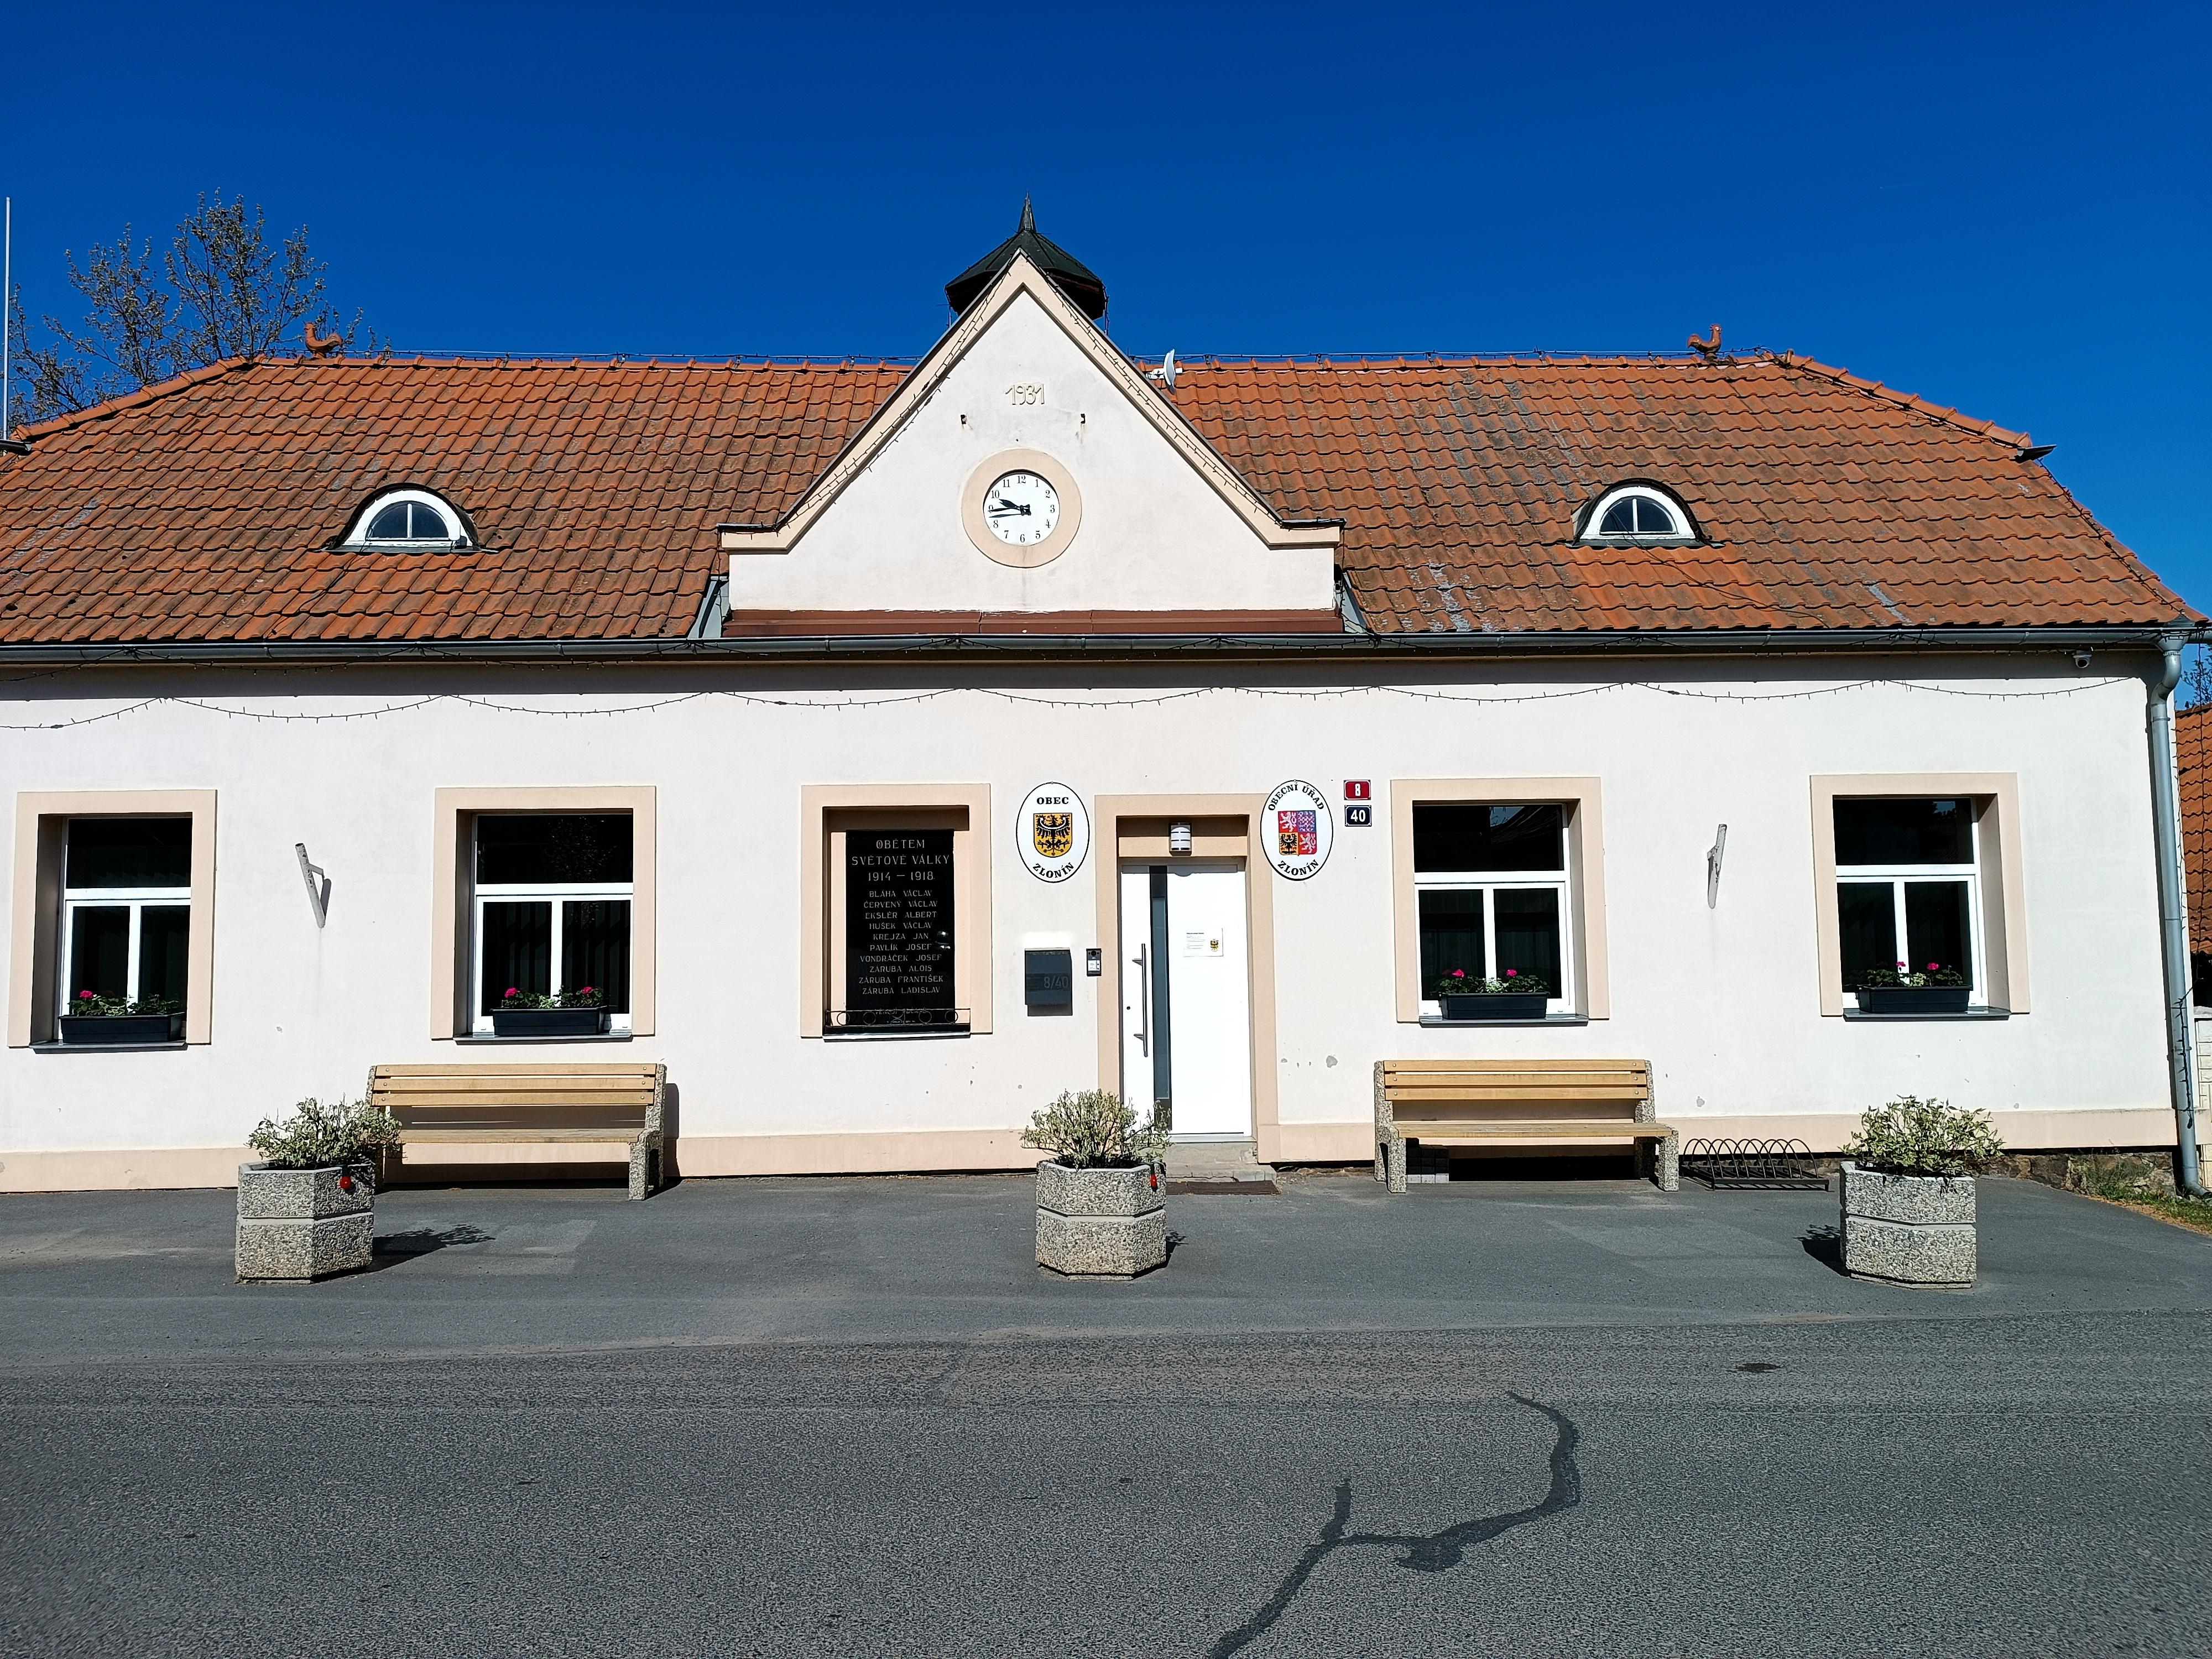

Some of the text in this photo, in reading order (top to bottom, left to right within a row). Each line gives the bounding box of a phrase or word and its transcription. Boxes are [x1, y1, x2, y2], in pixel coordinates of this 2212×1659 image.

[1005, 383, 1045, 405] 1931
[1003, 479, 1011, 487] 11
[1016, 475, 1026, 484] 12
[1035, 478, 1040, 487] 1
[990, 489, 1000, 499] 10
[1045, 489, 1051, 498] 2
[988, 504, 994, 513] 9
[1050, 504, 1055, 513] 3
[993, 519, 999, 529] 8
[1045, 519, 1051, 528] 4
[1004, 530, 1009, 539] 7
[1020, 534, 1025, 542] 6
[1035, 530, 1041, 539] 5
[1354, 783, 1361, 797] 8
[1268, 782, 1324, 811] OBECNÍ ÚŘAD
[1350, 809, 1366, 822] 40
[852, 854, 950, 865] SVĚTOVÉ VÁLKY
[1032, 862, 1074, 878] ZLONÍN
[1277, 859, 1319, 876] ZLONÍN
[868, 872, 891, 881] 1914
[911, 871, 933, 880] 1918
[869, 889, 896, 898] BLÁHA
[870, 943, 898, 951] PAVLÍK
[860, 953, 908, 962] VONDRÁČEK
[858, 974, 943, 984] ZÁRUBA FRANTIŠEK
[1044, 975, 1068, 989] 8/40
[862, 987, 894, 995] ZÁRUBA
